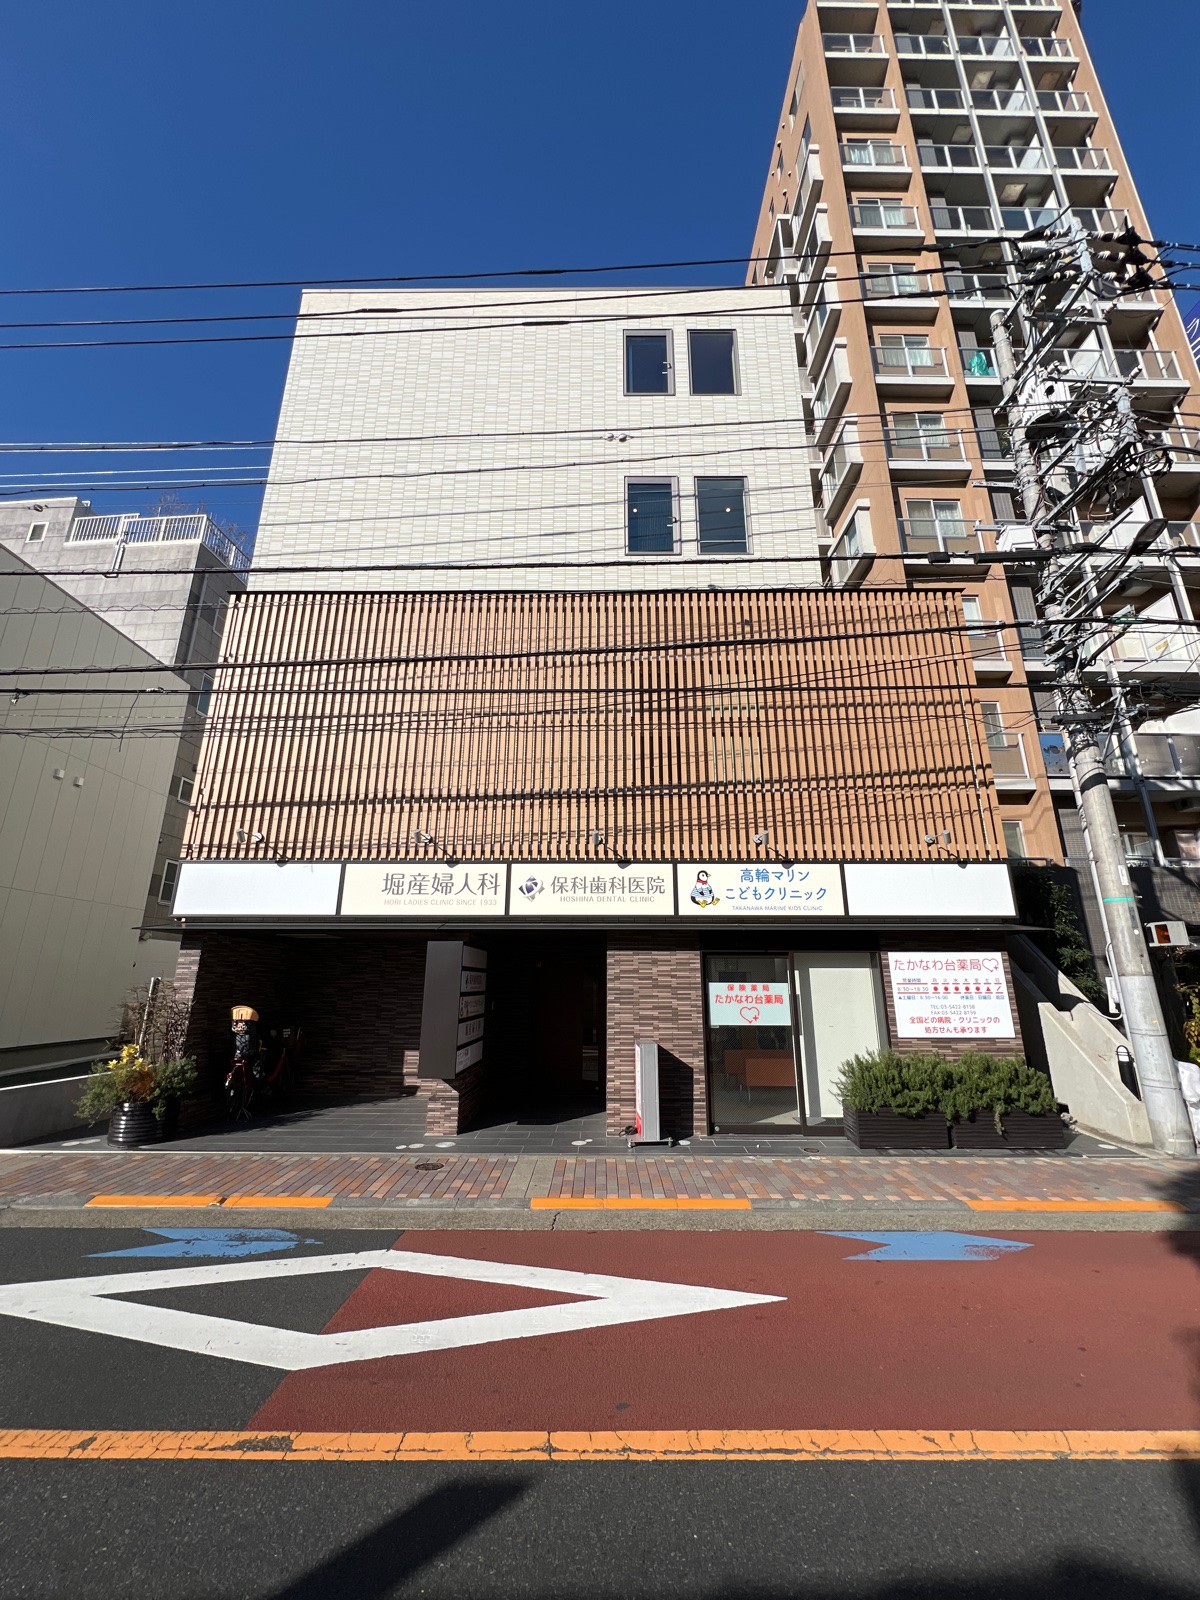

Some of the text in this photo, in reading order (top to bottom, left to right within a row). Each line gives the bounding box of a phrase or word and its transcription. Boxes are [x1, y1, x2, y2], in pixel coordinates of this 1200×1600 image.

[740, 868, 810, 882] 高輪マリン
[381, 872, 500, 895] 堀産婦人科
[550, 876, 666, 894] 保科歯科医院
[725, 886, 827, 900] こどもクリニック
[894, 959, 981, 971] たかなわ台薬局
[715, 994, 784, 1005] たかなわ台薬局
[924, 1026, 988, 1034] 処方せんも承ります
